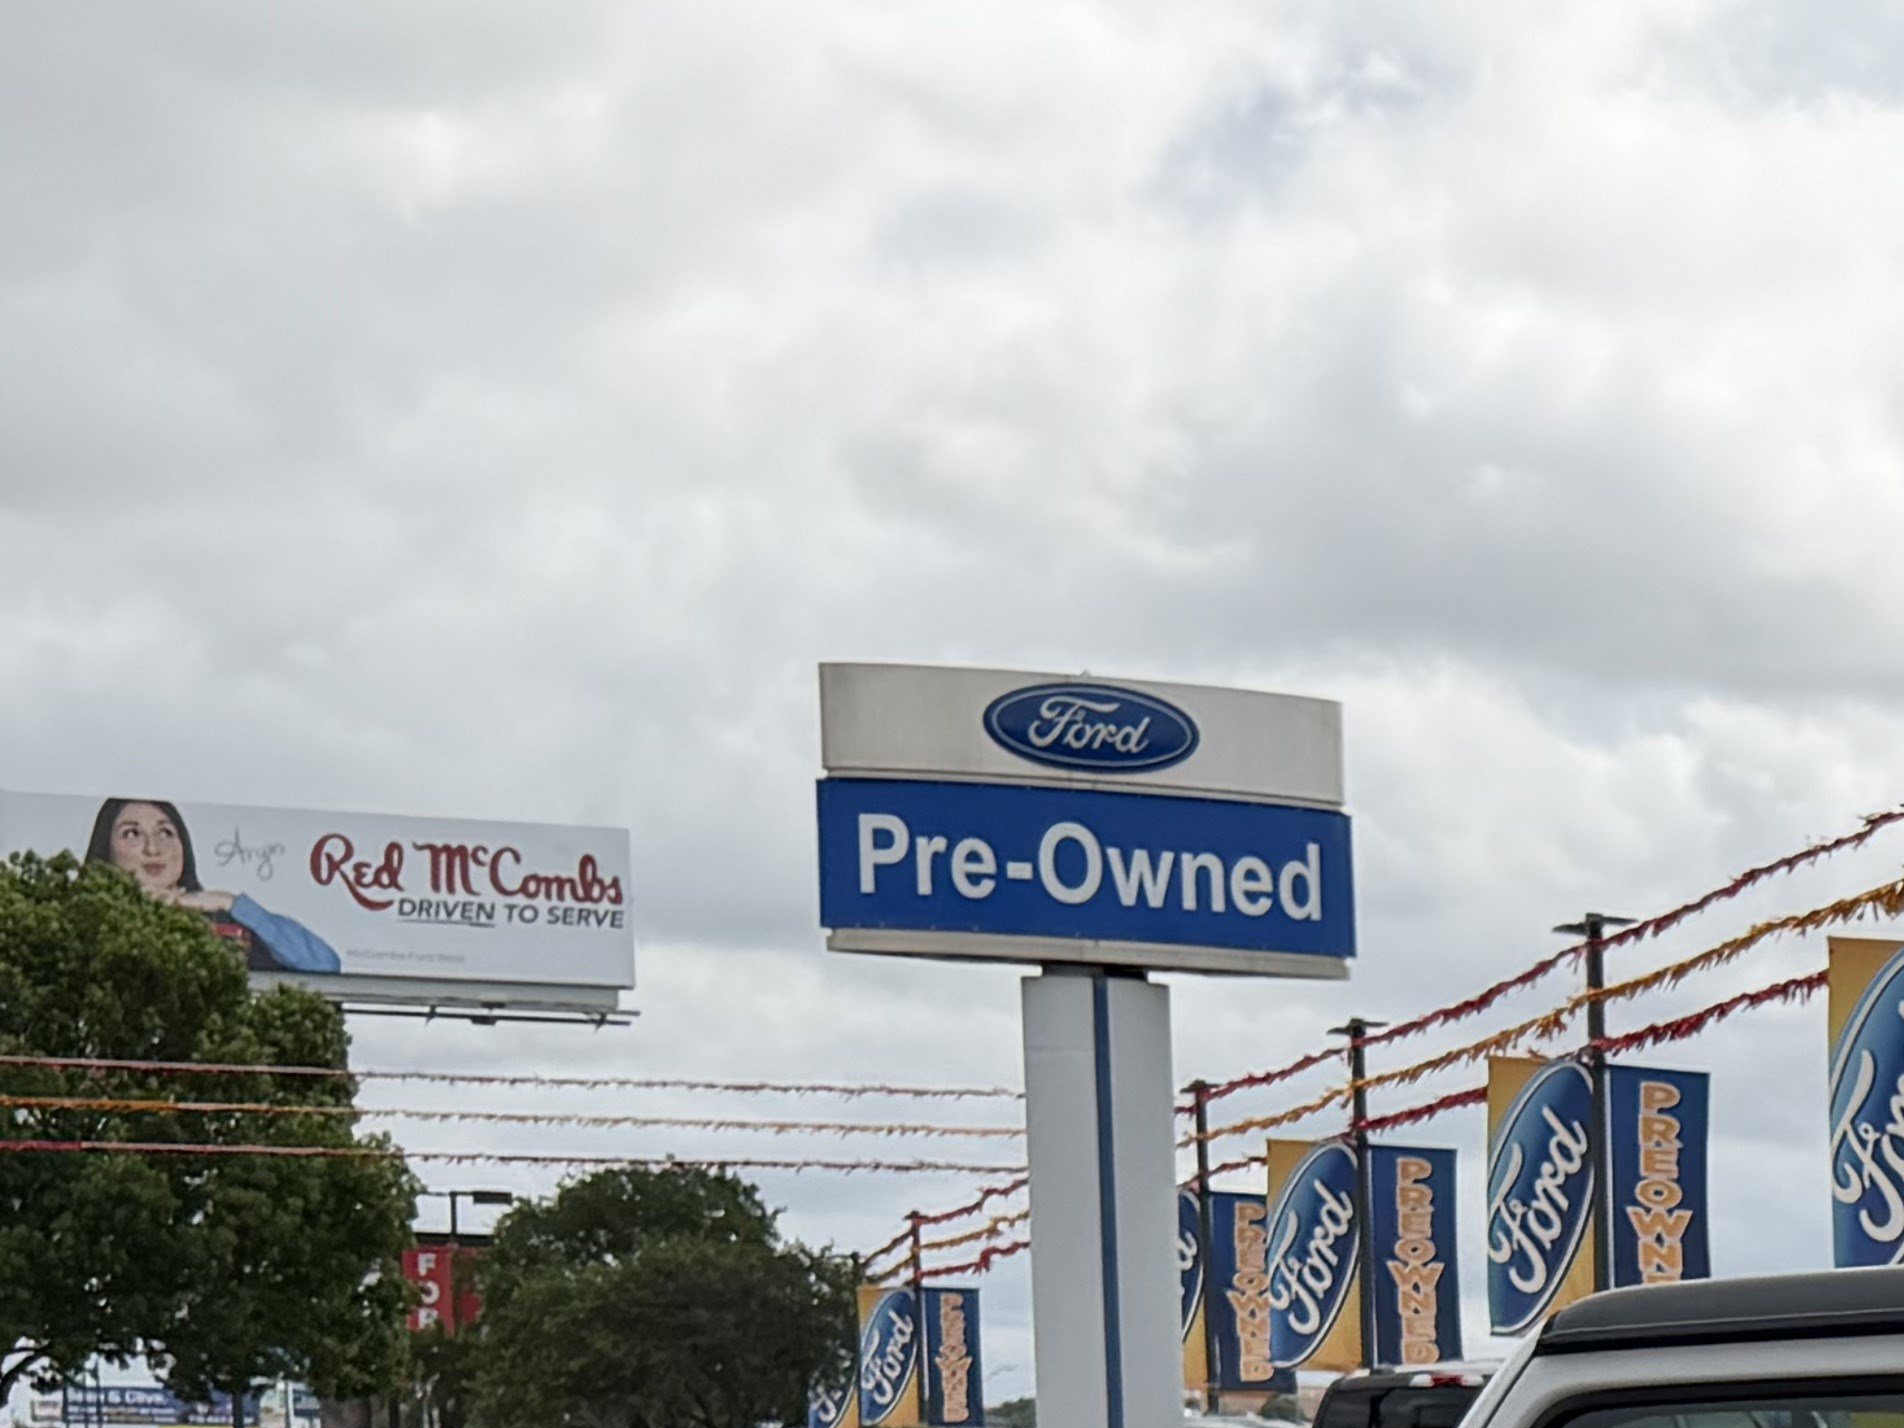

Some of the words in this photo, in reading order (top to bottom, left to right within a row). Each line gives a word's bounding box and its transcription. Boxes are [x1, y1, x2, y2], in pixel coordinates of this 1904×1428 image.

[1028, 695, 1152, 754] Ford
[310, 833, 404, 911] Red
[412, 841, 623, 905] McCombs
[398, 899, 495, 922] DRIVEN
[505, 902, 540, 924] TO
[547, 906, 624, 930] SERVE
[857, 812, 1323, 922] Pre-Owned
[1487, 1106, 1588, 1294] Ford
[1626, 1081, 1692, 1284] PREOWN
[1269, 1180, 1353, 1335] Ford
[861, 1309, 914, 1404] Ford
